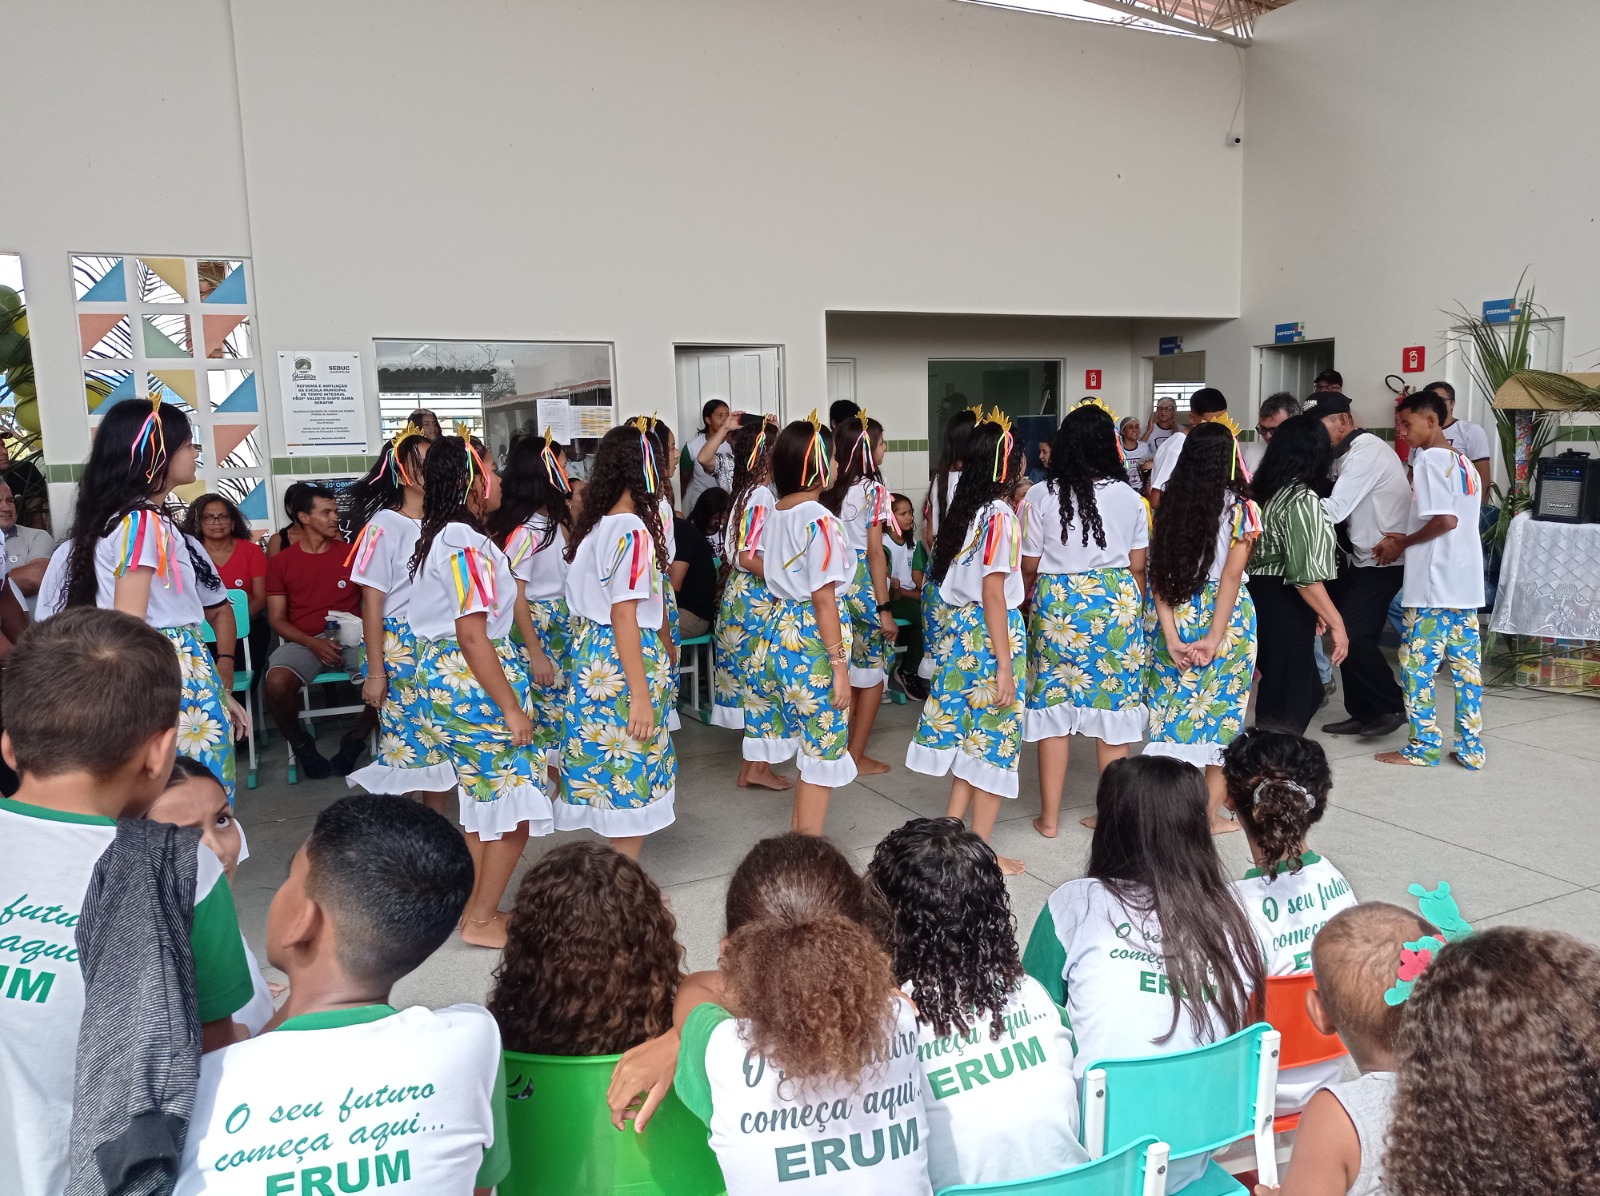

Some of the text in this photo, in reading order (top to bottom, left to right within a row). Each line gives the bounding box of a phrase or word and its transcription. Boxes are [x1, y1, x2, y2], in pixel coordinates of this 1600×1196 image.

[0, 893, 80, 925] futu
[1262, 896, 1279, 922] O
[1287, 892, 1315, 914] seu
[1115, 922, 1162, 944] O se
[926, 1035, 1047, 1101] ERUM
[224, 1082, 436, 1135] O seu futuro
[740, 1097, 853, 1133] começa
[214, 1111, 445, 1172] começa aqui...
[774, 1116, 920, 1183] ERUM
[266, 1148, 412, 1196] ERUM
